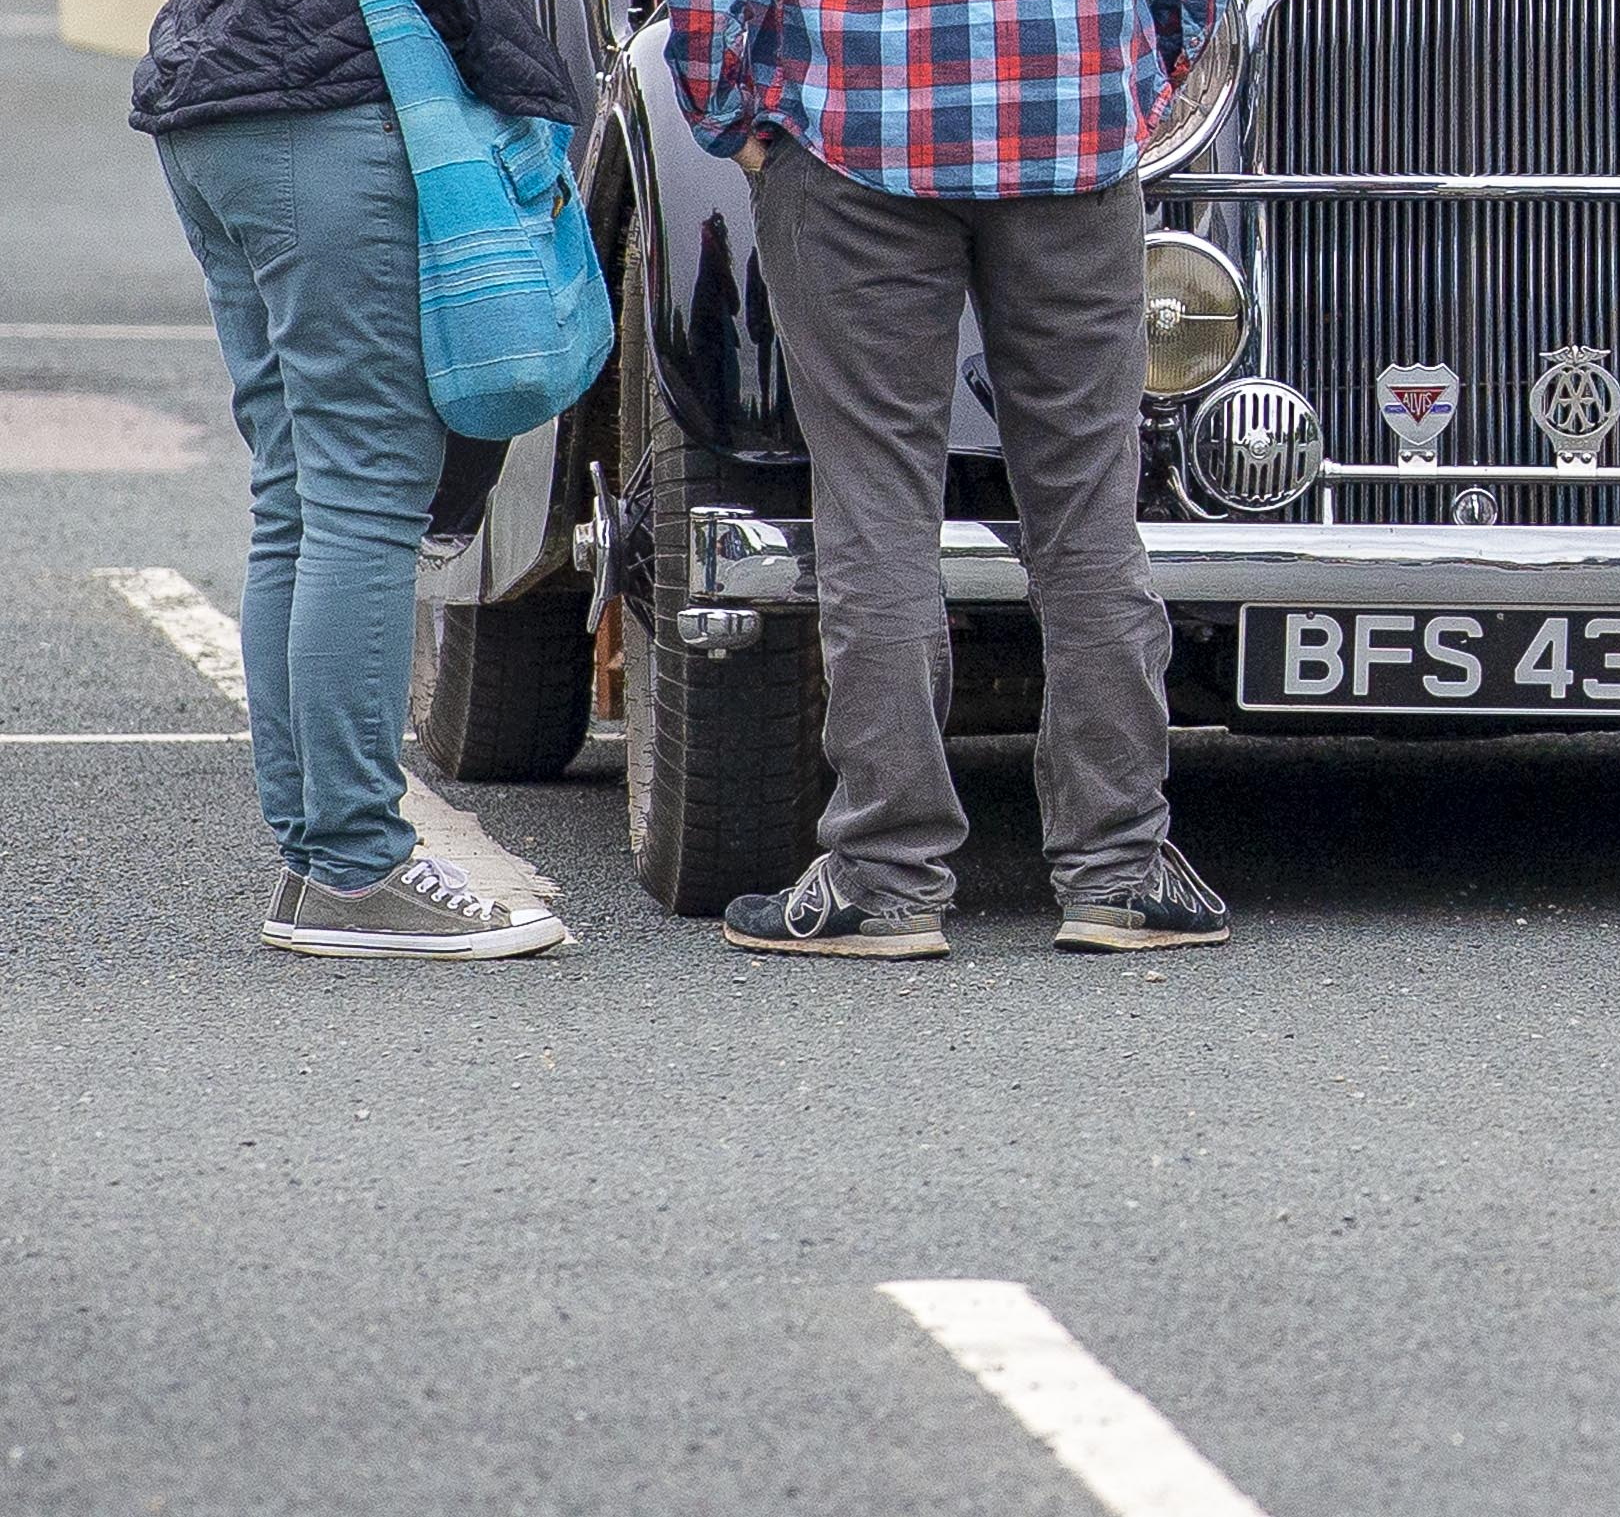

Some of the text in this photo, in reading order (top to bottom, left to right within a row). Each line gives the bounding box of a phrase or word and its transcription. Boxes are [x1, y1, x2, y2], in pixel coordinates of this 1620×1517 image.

[1402, 391, 1433, 416] ALVIS
[1544, 368, 1610, 432] AA
[1283, 613, 1484, 698] BFS
